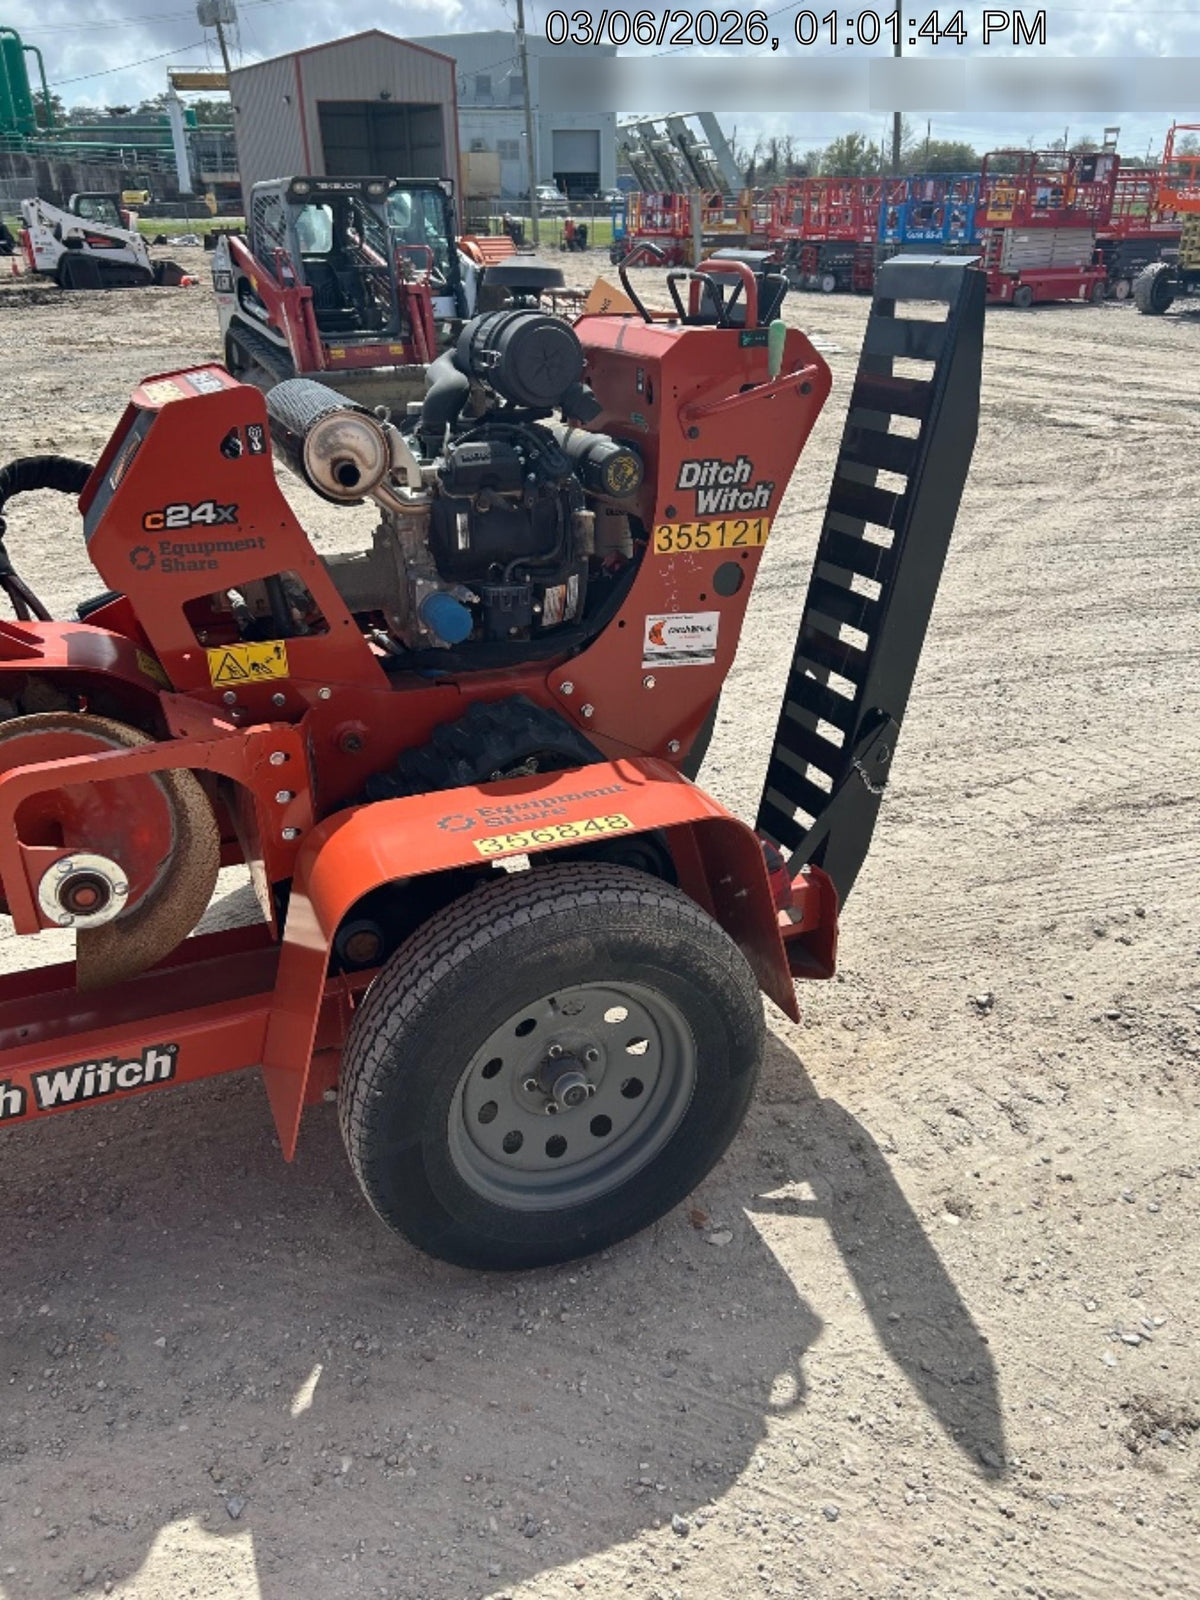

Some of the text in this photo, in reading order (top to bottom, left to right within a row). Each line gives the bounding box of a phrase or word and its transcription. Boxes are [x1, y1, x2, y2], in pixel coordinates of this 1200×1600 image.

[677, 457, 752, 489] Ditch
[697, 484, 772, 514] Witch
[158, 537, 266, 556] Equipment
[657, 519, 764, 551] 355121
[161, 559, 218, 573] Share
[476, 784, 627, 817] Equipment
[484, 806, 569, 828] Share
[479, 814, 629, 854] 356848
